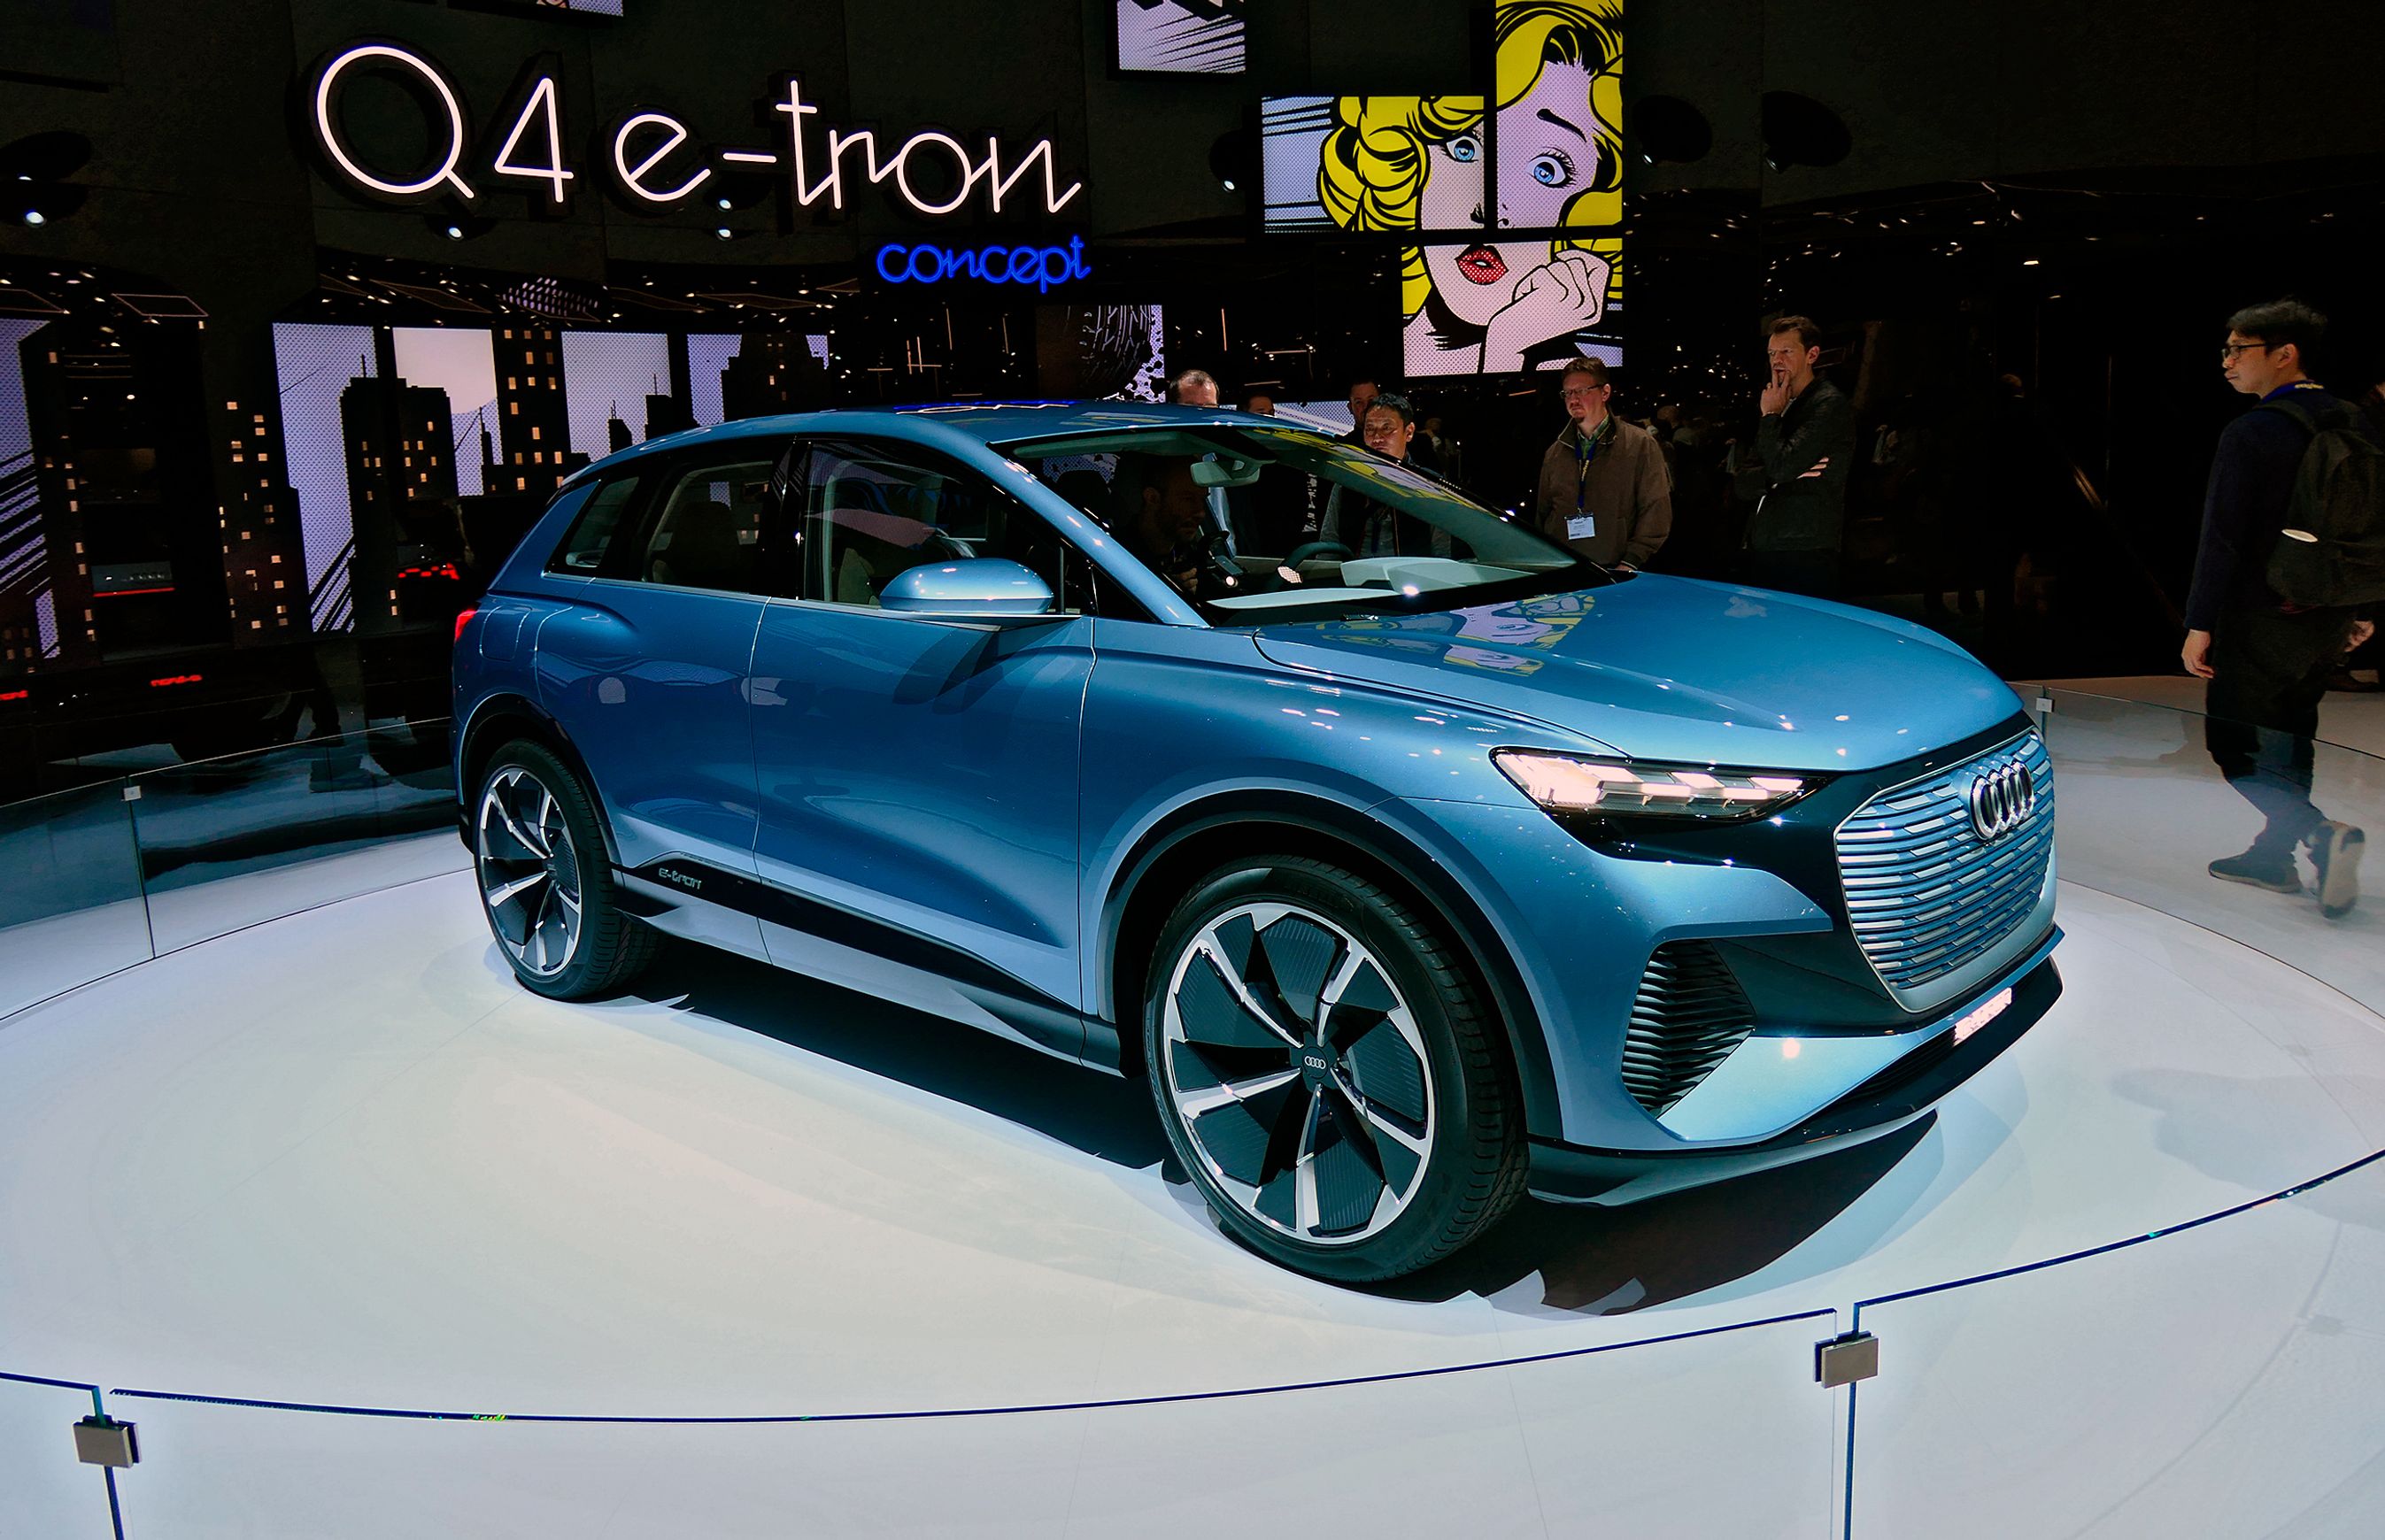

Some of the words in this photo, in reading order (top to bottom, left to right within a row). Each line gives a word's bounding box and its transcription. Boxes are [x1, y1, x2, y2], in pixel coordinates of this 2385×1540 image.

[316, 45, 575, 203] Q4
[614, 79, 1082, 214] e-tron
[876, 234, 1092, 294] concept
[658, 867, 702, 889] e-tron
